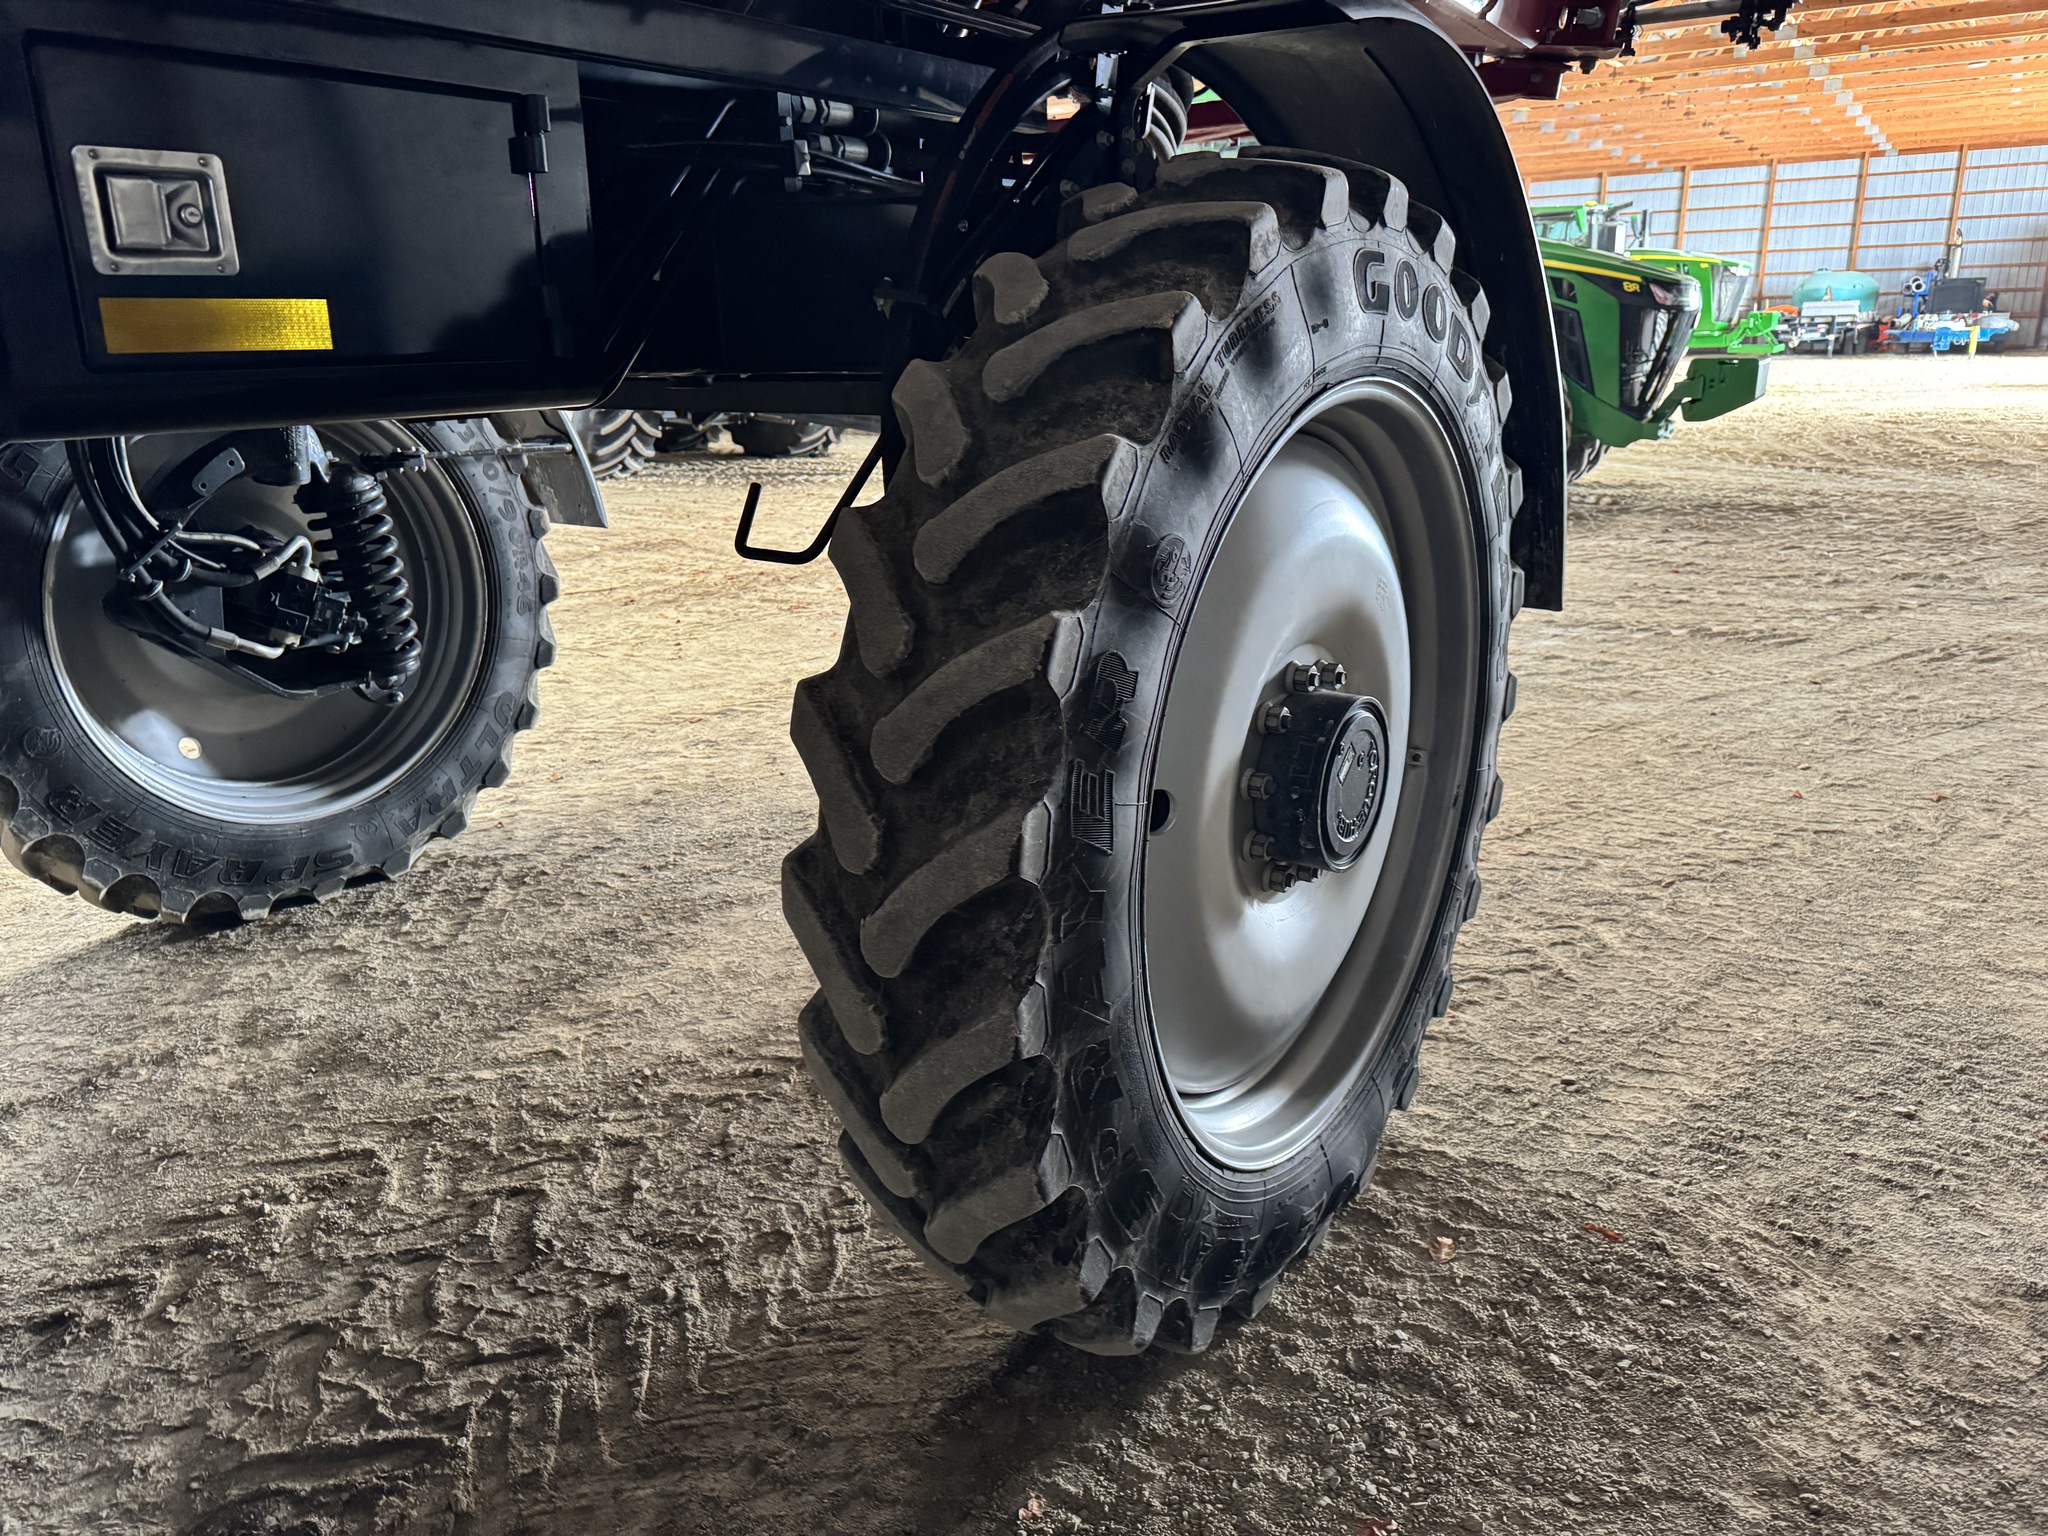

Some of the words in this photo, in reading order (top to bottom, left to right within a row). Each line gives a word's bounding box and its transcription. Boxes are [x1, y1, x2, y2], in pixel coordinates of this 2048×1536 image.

[1623, 281, 1640, 293] 8R
[1159, 382, 1214, 464] RADIAL
[1214, 290, 1281, 369] TUBELESS
[394, 692, 517, 838] ULTRA
[48, 784, 356, 886] SPRAYER
